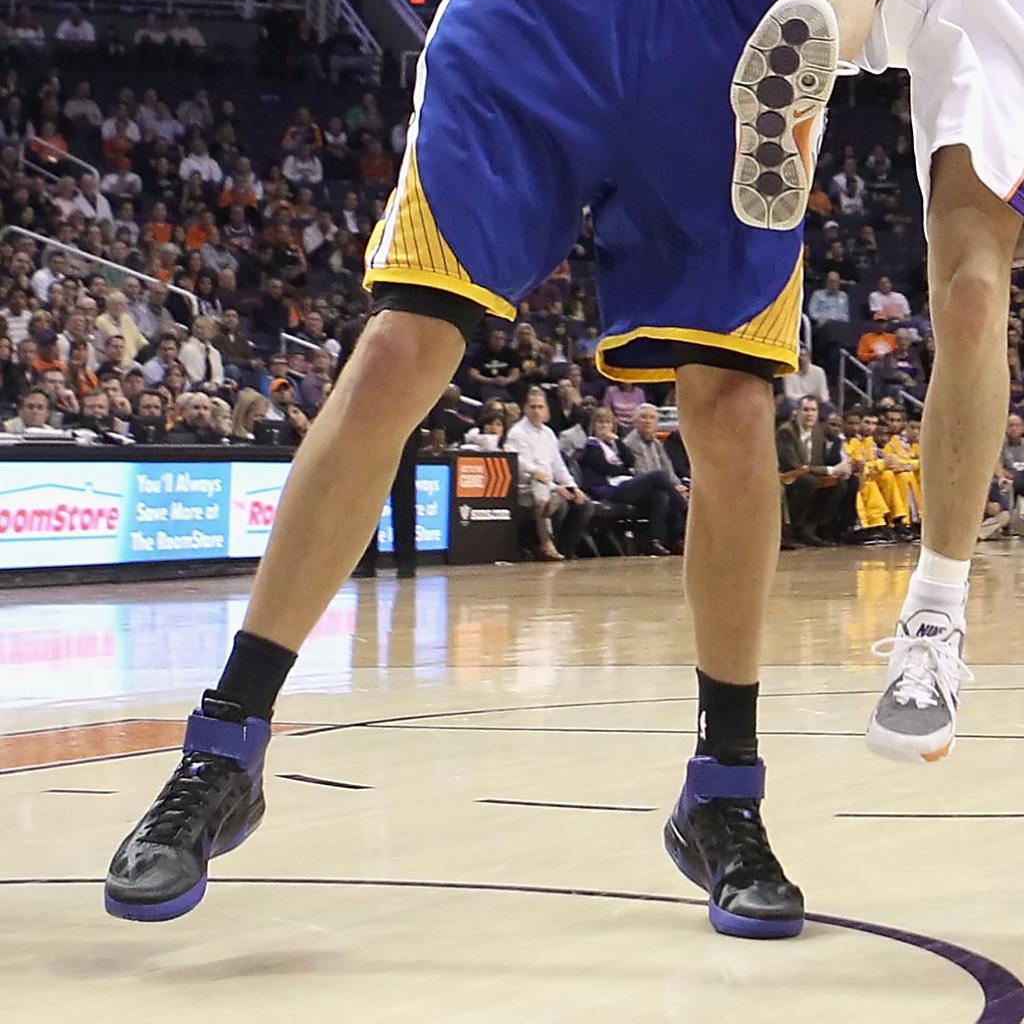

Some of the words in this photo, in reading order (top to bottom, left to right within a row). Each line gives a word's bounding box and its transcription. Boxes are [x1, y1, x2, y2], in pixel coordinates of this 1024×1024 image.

[175, 472, 223, 498] Always
[170, 502, 205, 521] More
[130, 531, 155, 551] The
